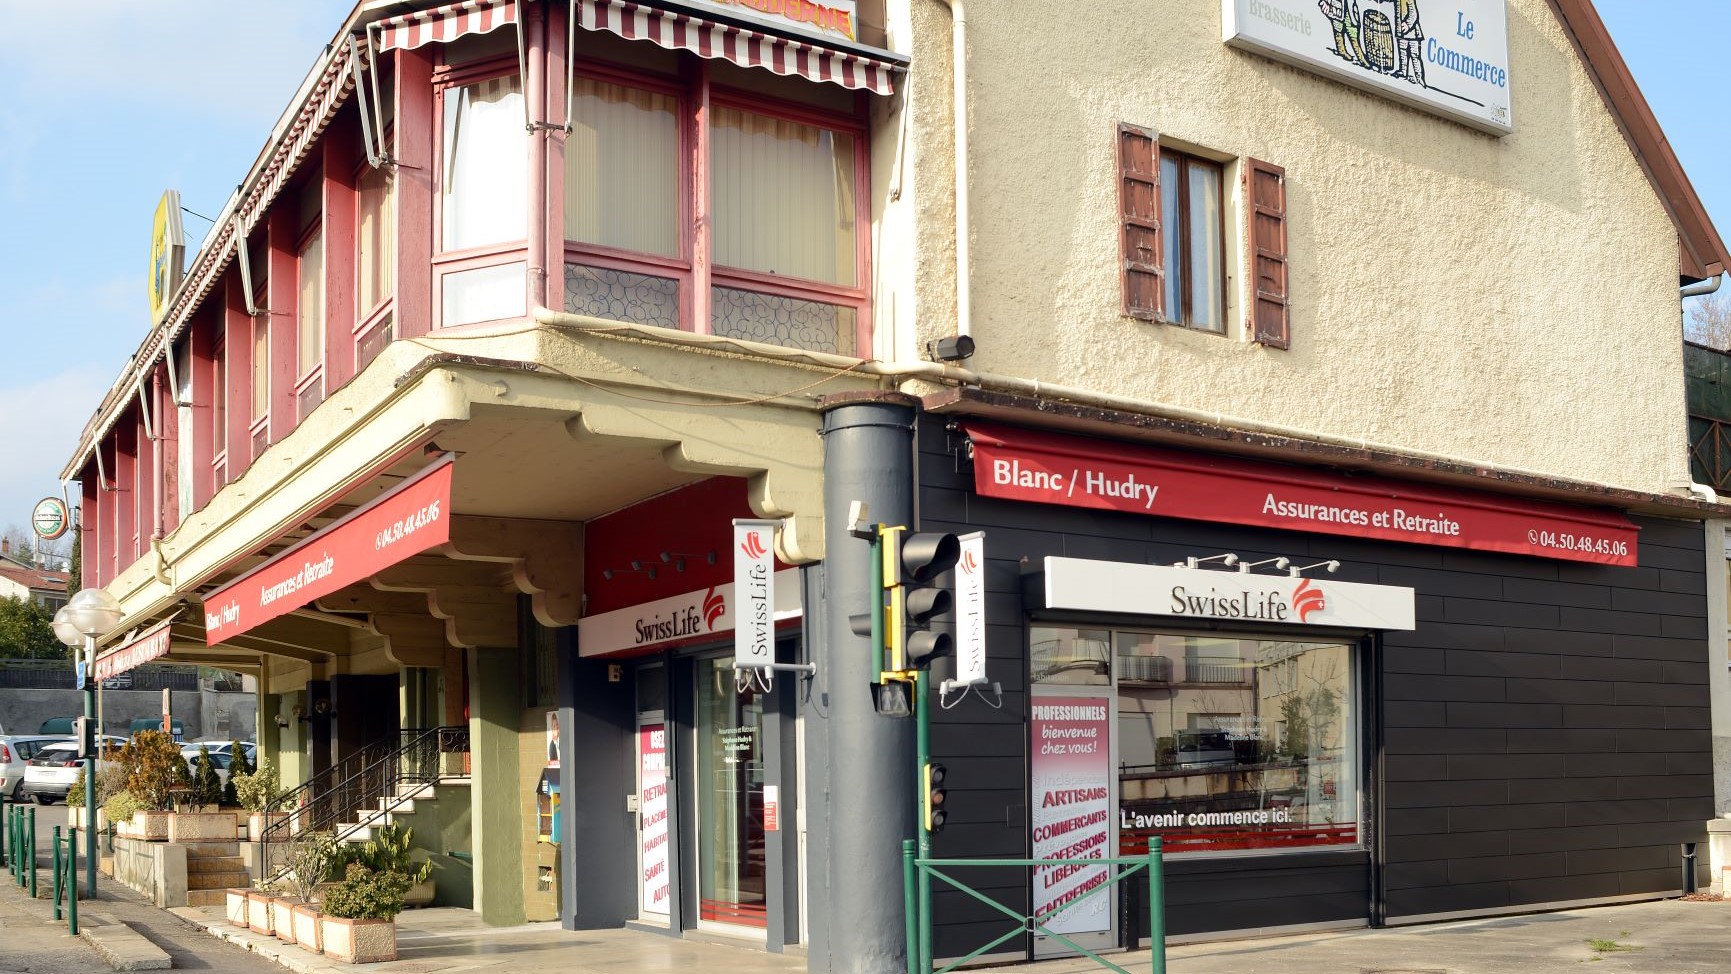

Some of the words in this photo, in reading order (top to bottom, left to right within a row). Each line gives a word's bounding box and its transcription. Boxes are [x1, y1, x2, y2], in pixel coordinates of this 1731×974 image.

[740, 0, 856, 42] ODERNE
[1248, 0, 1312, 37] Brasserie
[1457, 11, 1474, 40] Le
[1427, 38, 1506, 88] Commerce
[993, 459, 1063, 491] Blanc
[1067, 469, 1079, 497] /
[1085, 470, 1159, 509] Hudry
[1262, 493, 1369, 526] Assurances
[1372, 510, 1390, 528] et
[1393, 508, 1460, 536] Retraite
[1540, 530, 1627, 556] 04.50.48.45.06
[206, 609, 221, 633] Blanc
[223, 600, 240, 626] Hudry
[260, 577, 297, 607] Assurances
[296, 572, 304, 589] et
[304, 552, 334, 586] Retraite
[382, 500, 440, 548] 04.50.48.45.06
[750, 563, 768, 657] SwissLife
[1170, 585, 1288, 621] SwissLife
[635, 605, 701, 644] SwissLife
[1032, 705, 1106, 721] PROFESSIONNELS
[1041, 724, 1097, 739] bienvenue
[1041, 743, 1066, 755] chez
[1068, 741, 1097, 754] vous!
[1042, 787, 1107, 808] ARTISANS
[1121, 809, 1185, 829] L'avenir
[1188, 810, 1268, 827] commence
[1272, 807, 1292, 823] ici.
[645, 858, 665, 882] SANTÉ
[1033, 831, 1107, 875] PROFESSIONS
